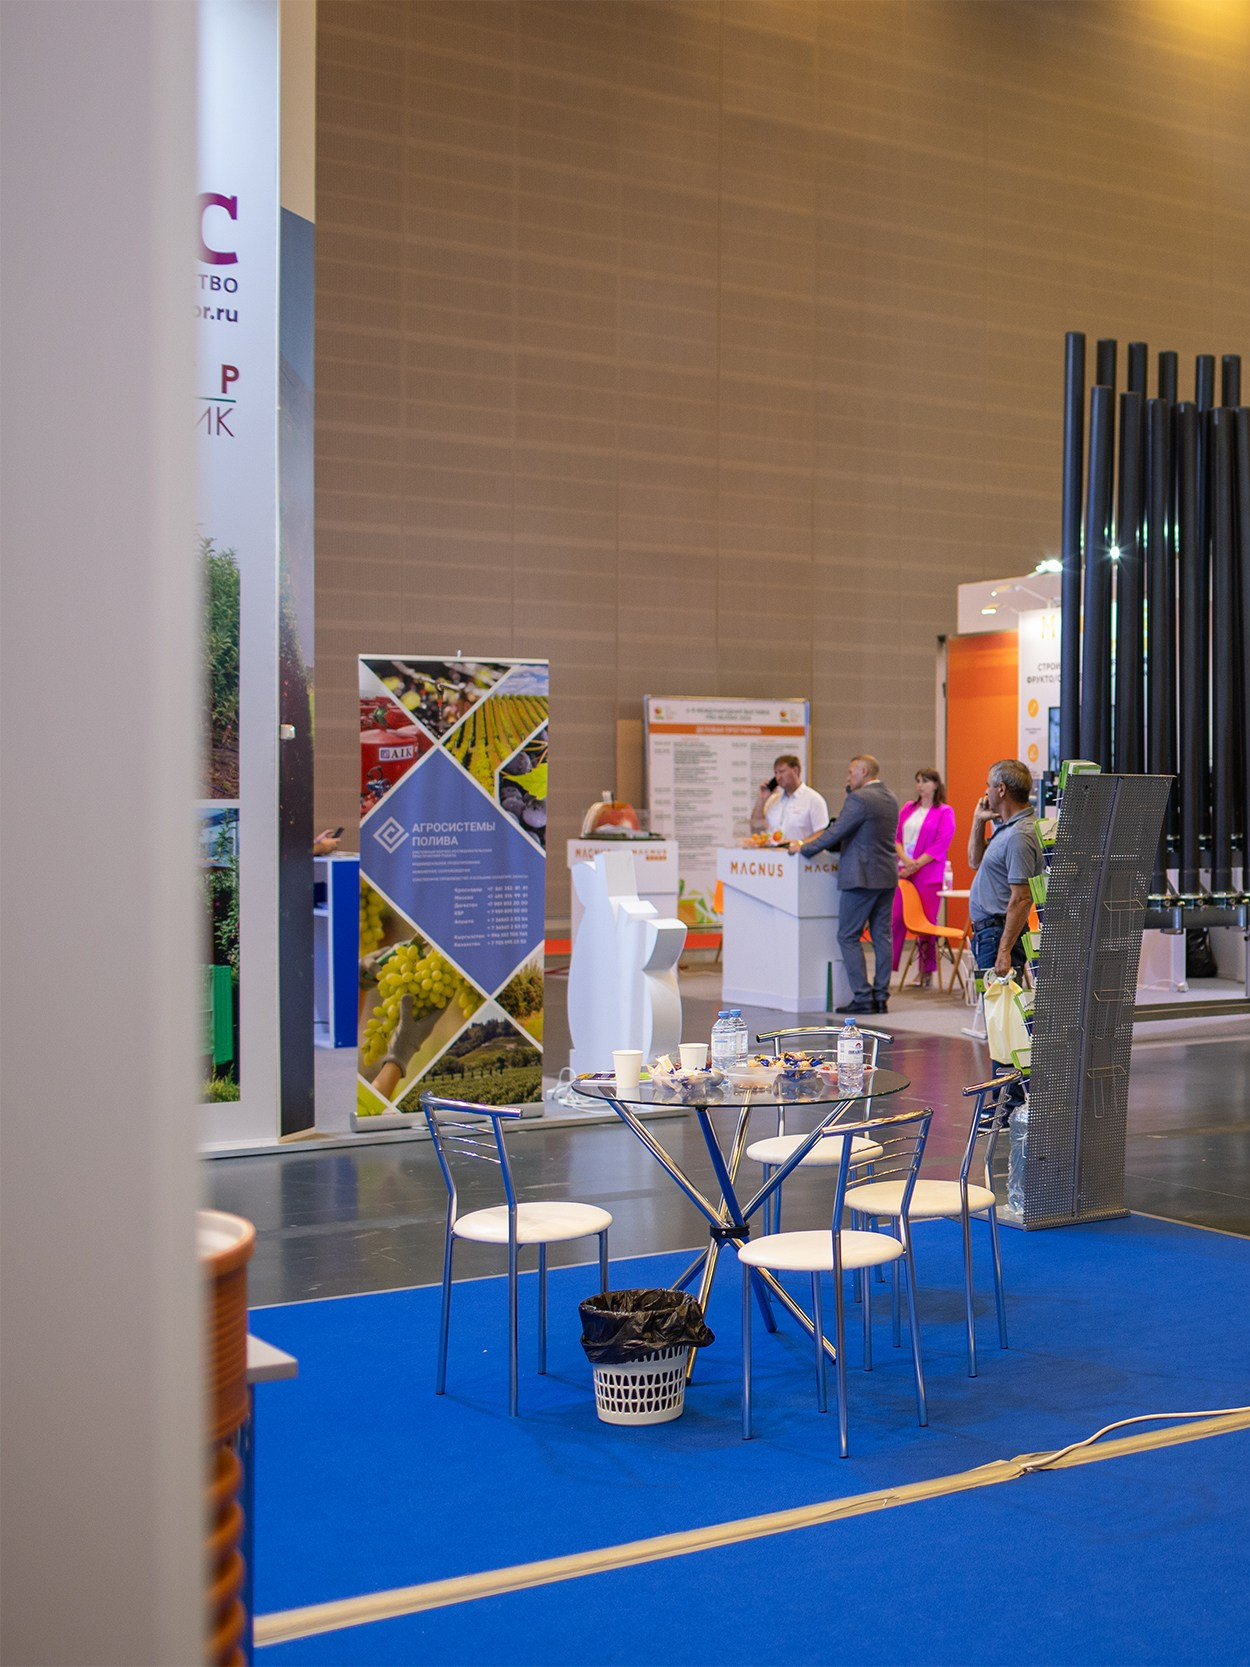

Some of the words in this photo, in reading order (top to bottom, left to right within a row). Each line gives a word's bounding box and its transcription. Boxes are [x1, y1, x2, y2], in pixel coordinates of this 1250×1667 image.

[412, 821, 496, 833] АГРОСИСТЕМЫ
[412, 836, 459, 846] ПОЛИВА
[730, 861, 784, 877] MAGNUS
